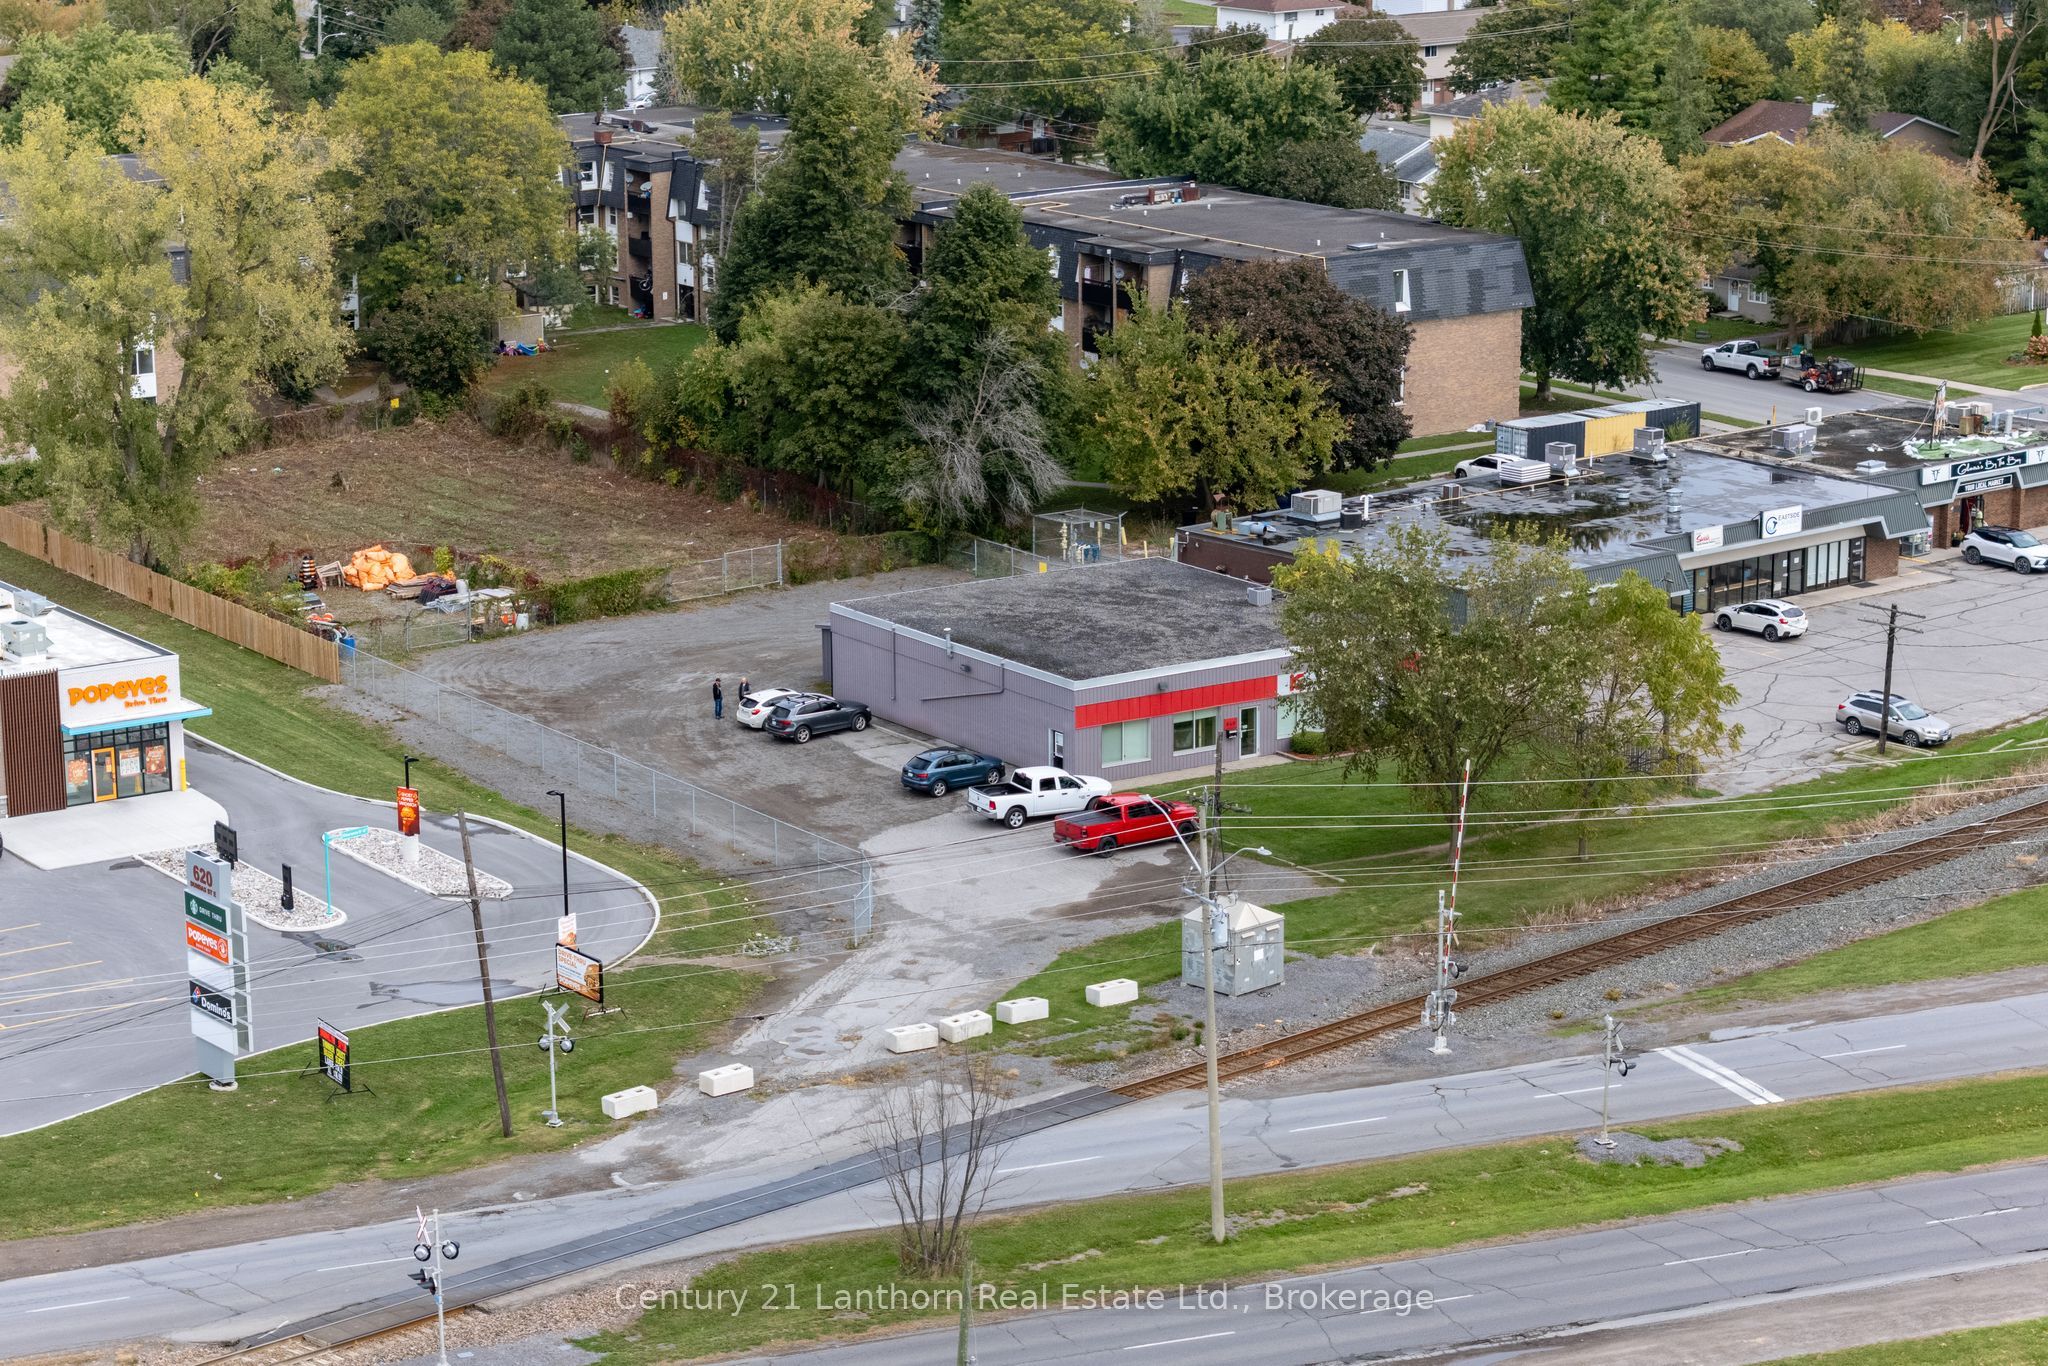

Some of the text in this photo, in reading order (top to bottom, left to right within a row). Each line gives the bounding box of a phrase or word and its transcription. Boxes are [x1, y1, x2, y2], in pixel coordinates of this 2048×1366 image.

[1976, 481, 1987, 490] LOCAL
[1988, 478, 2004, 488] MARKET
[1778, 512, 1800, 521] EASTSIDE
[193, 865, 213, 888] 620
[199, 906, 222, 923] DRIVE THRU
[201, 996, 231, 1020] Domino's
